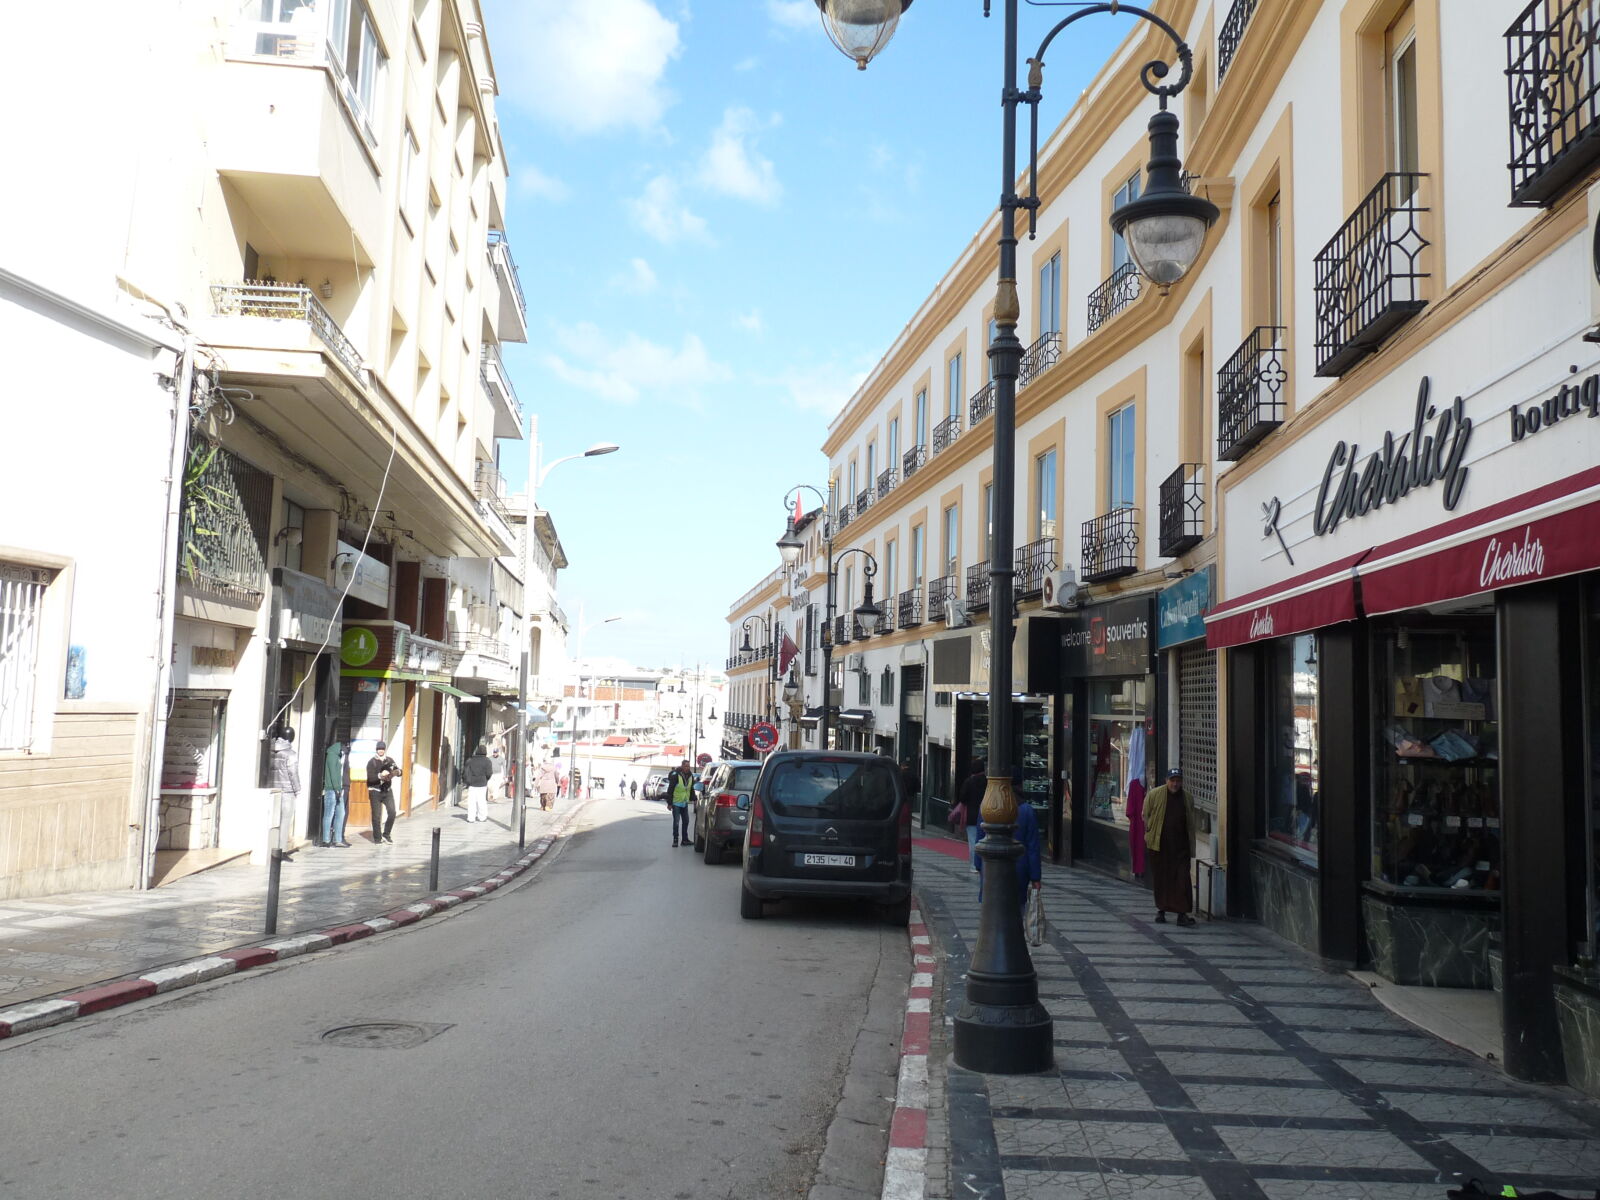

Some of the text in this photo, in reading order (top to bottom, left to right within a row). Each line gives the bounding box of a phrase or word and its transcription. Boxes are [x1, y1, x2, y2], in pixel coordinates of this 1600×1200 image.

[1313, 376, 1472, 536] Chevalier
[1480, 526, 1545, 588] Chevalier
[1061, 627, 1091, 648] welcome
[1106, 616, 1148, 643] souvenirs
[806, 855, 826, 864] 2135
[843, 856, 854, 866] 40
